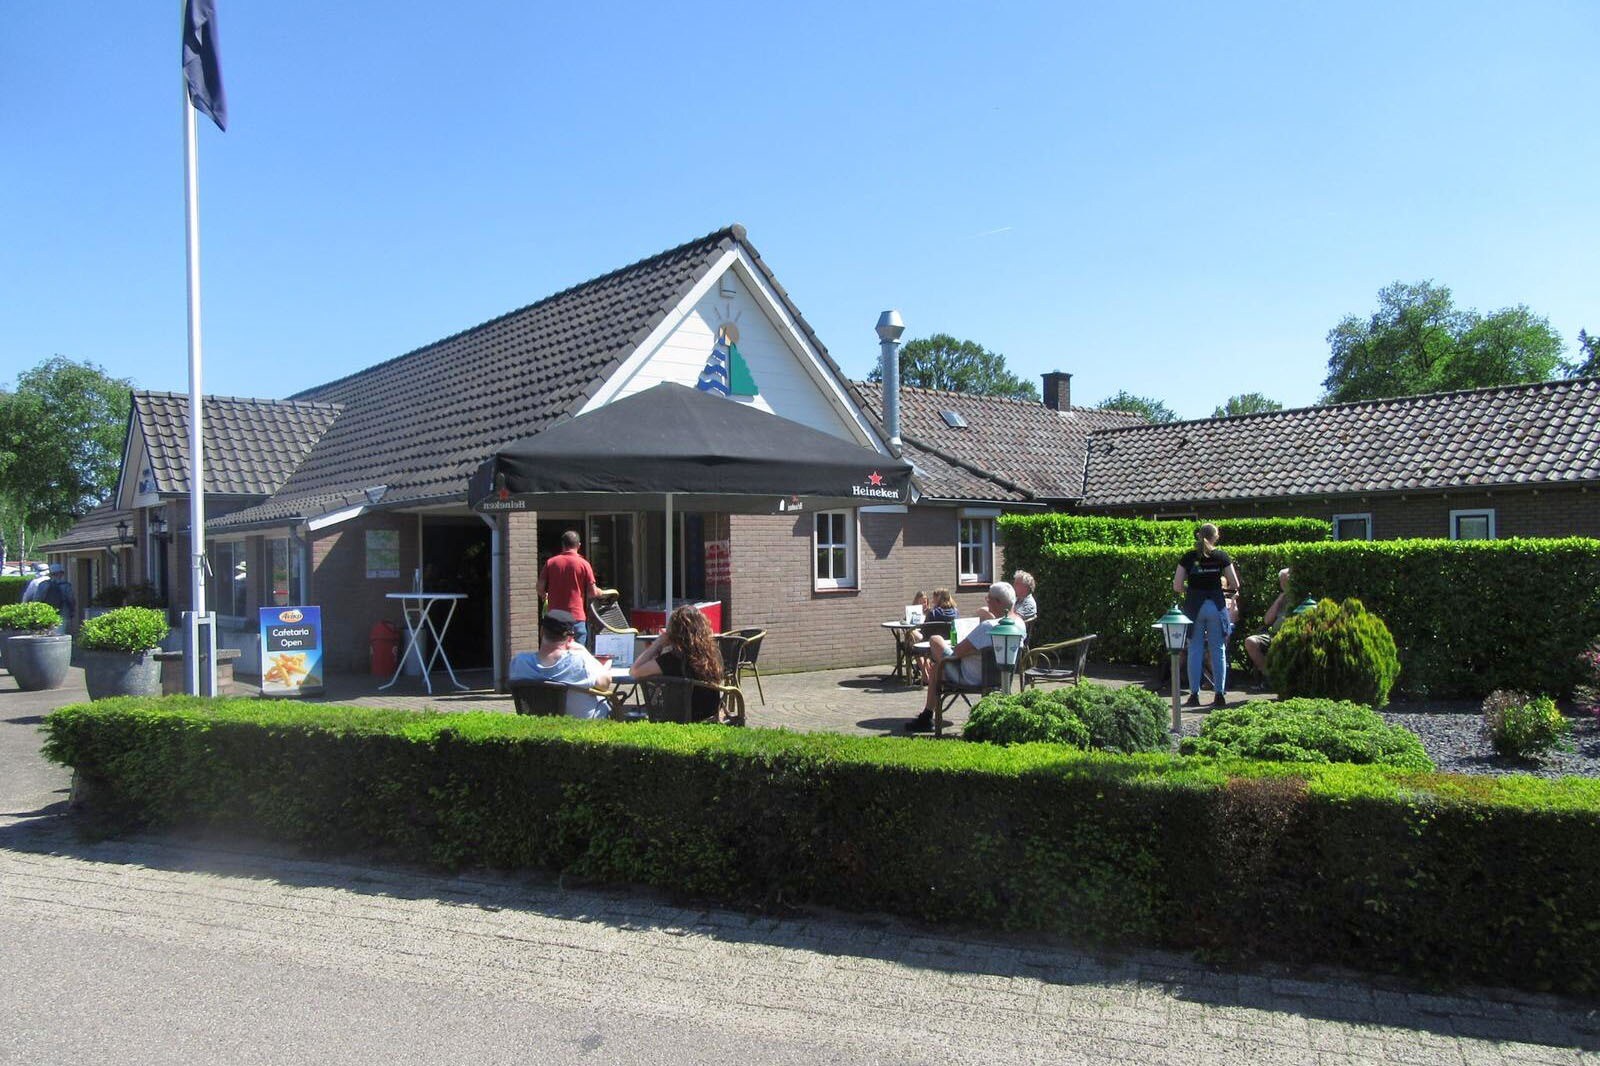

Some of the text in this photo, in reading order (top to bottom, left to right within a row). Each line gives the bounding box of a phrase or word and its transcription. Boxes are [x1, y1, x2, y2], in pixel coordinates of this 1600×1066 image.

[852, 485, 899, 499] Heineken
[273, 628, 309, 637] Cafetaria
[281, 639, 303, 648] Open
